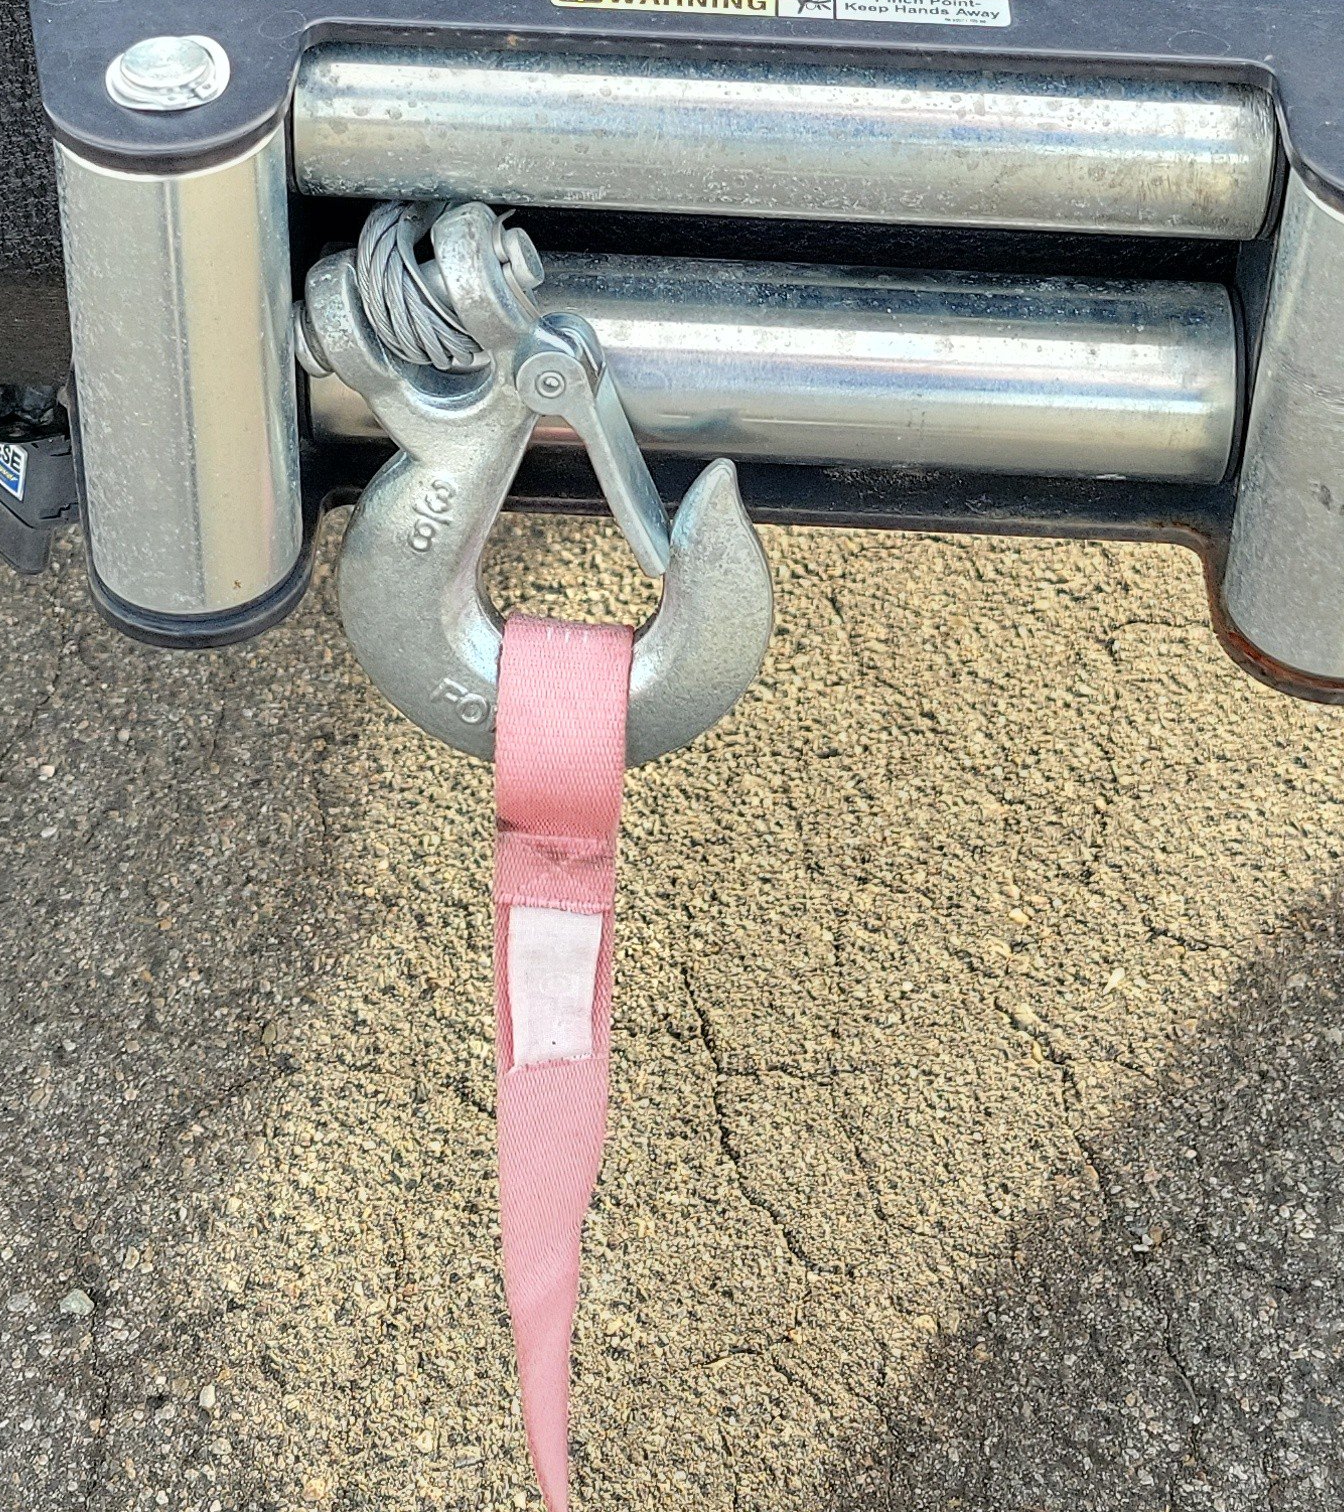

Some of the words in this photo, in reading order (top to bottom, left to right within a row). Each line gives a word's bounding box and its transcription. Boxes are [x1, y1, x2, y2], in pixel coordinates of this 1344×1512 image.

[844, 2, 889, 13] Keep
[894, 4, 950, 15] Hands
[956, 8, 1000, 19] Away
[431, 678, 497, 733] FO
